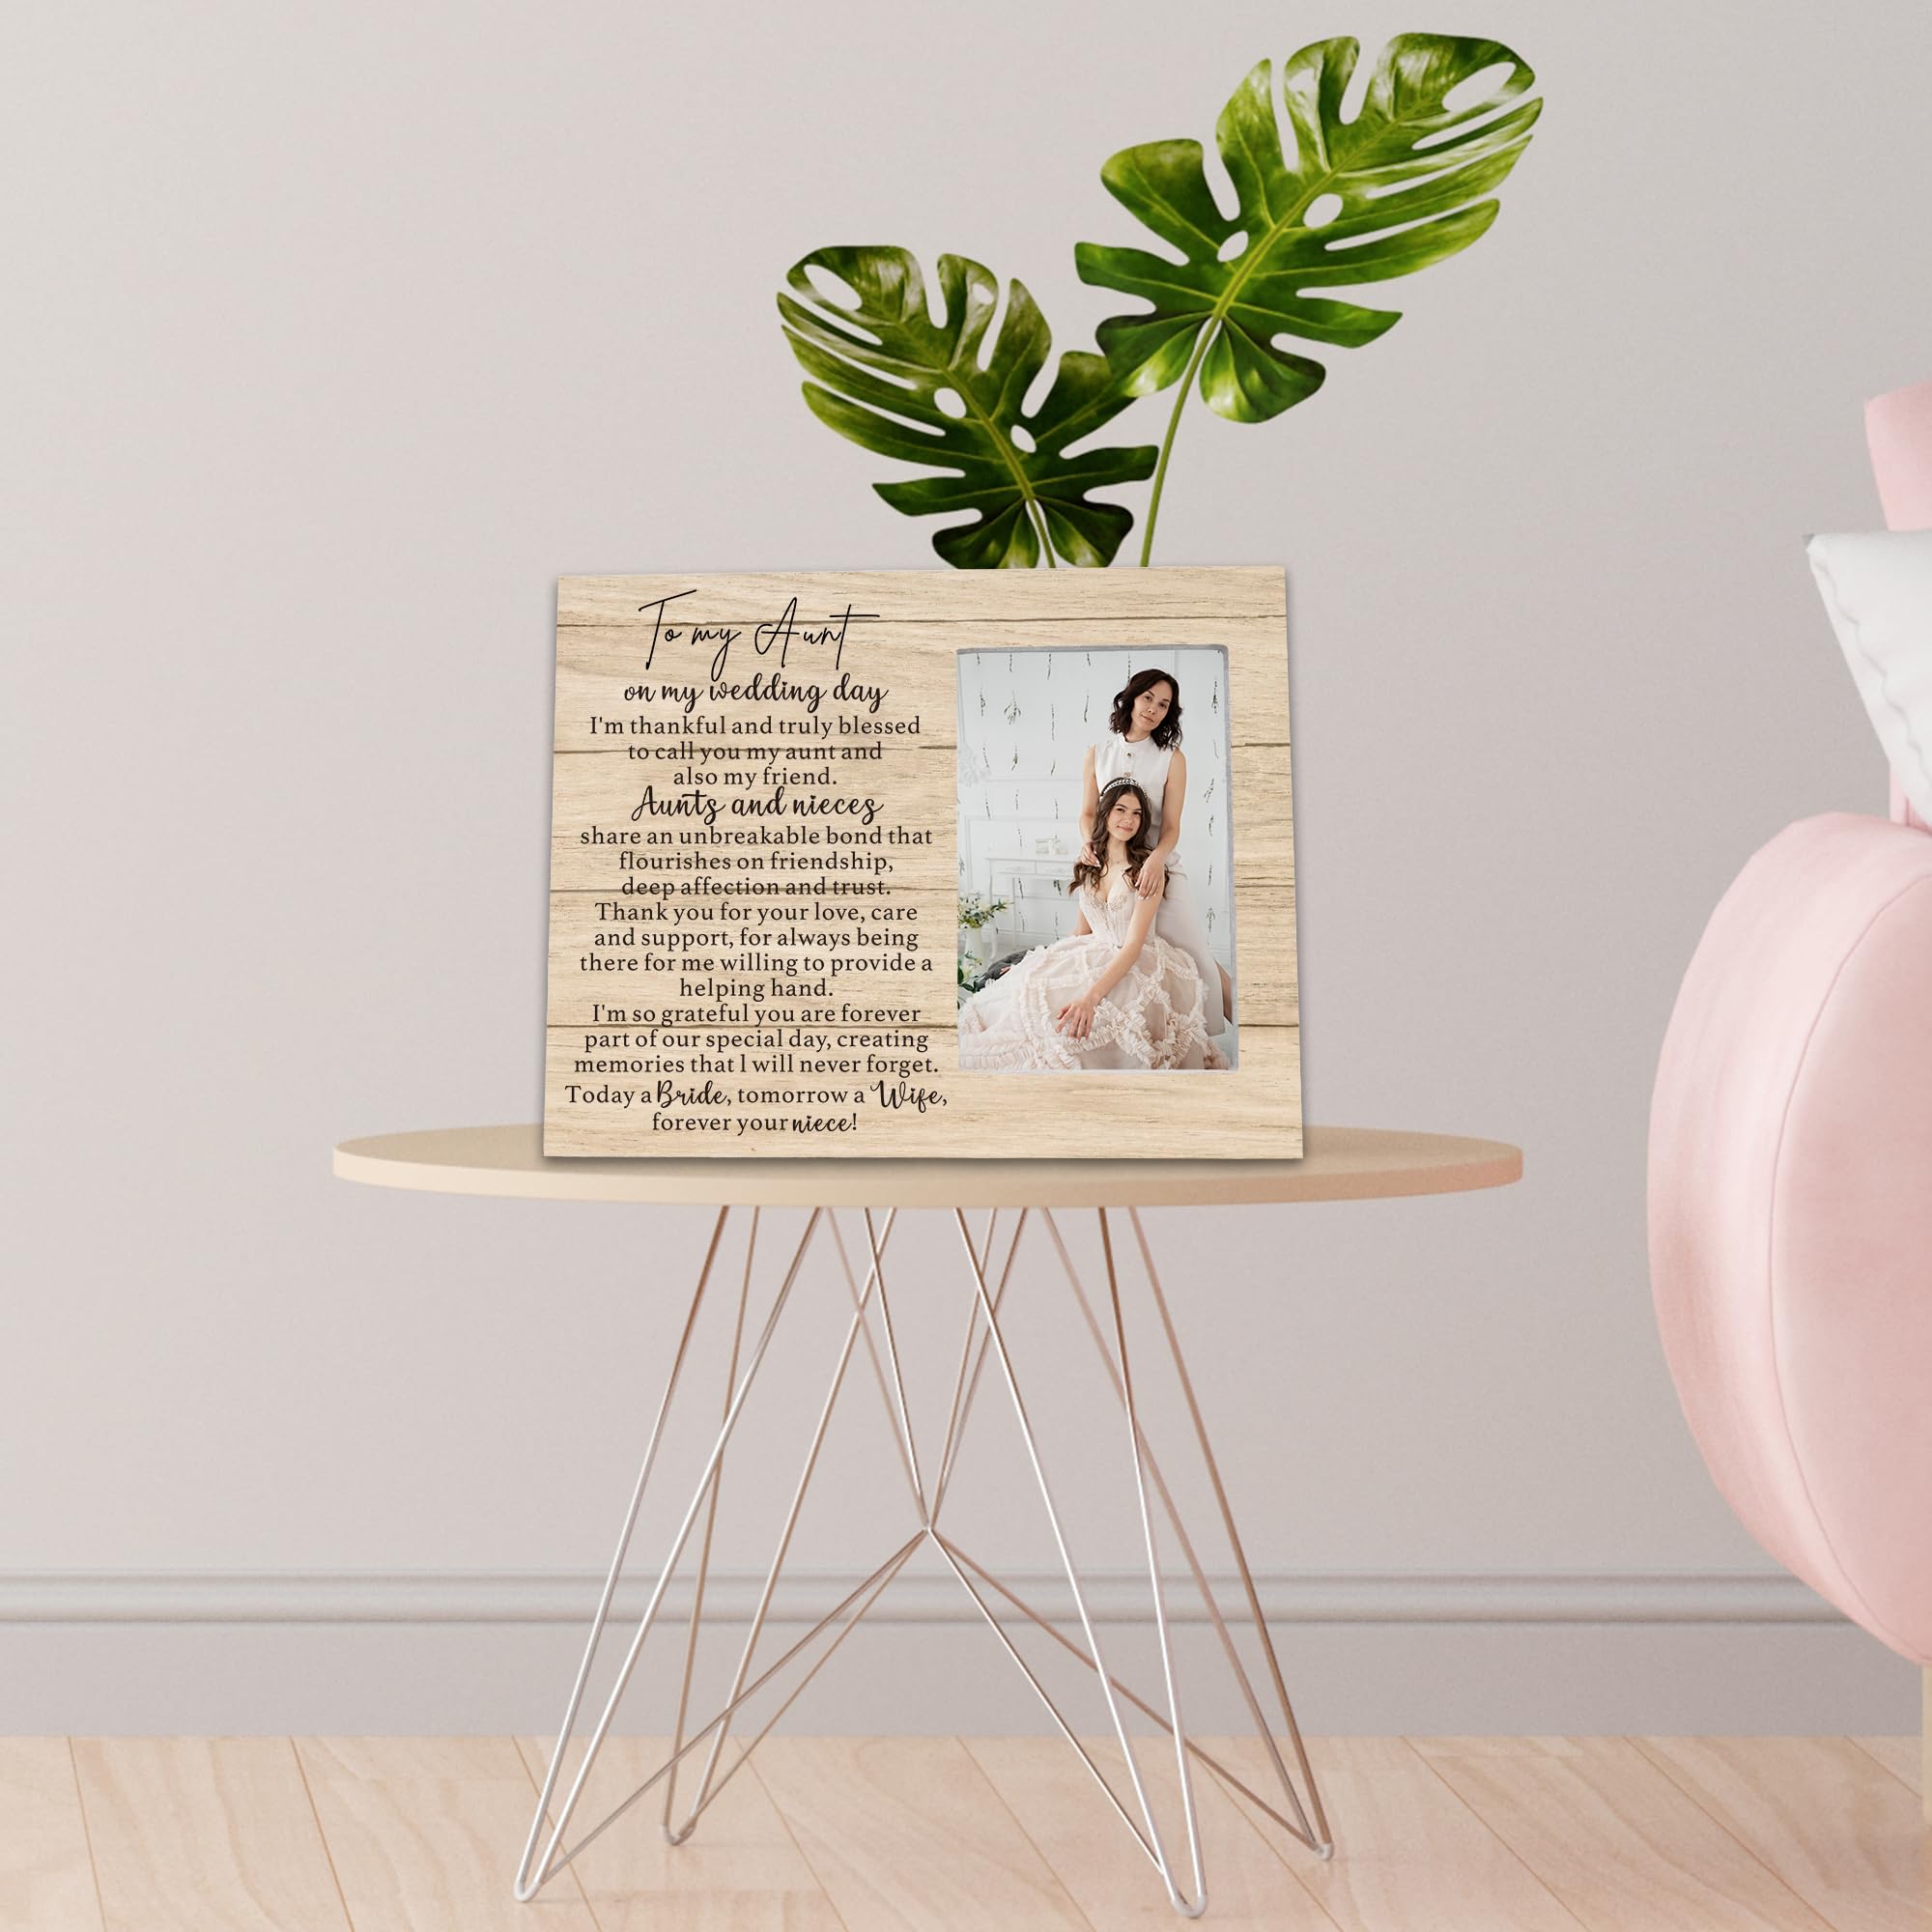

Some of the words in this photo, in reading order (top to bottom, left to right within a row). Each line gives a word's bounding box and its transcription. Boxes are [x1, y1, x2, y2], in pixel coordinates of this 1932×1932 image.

[638, 589, 697, 670] To
[691, 627, 742, 683] my
[754, 596, 880, 670] Aunt
[624, 685, 657, 702] on
[662, 685, 704, 714] my
[709, 672, 828, 714] wedding
[833, 672, 890, 714] day
[590, 716, 624, 734] I'm
[630, 715, 725, 734] thankful
[731, 715, 773, 734] and
[779, 715, 833, 740] truly
[838, 715, 921, 735] blessed
[628, 745, 649, 760] to
[655, 741, 694, 760] call
[699, 747, 741, 766] you
[746, 747, 781, 765] my
[785, 745, 836, 760] aunt
[840, 741, 882, 760] and
[673, 766, 718, 785] also
[724, 772, 756, 790] my
[763, 766, 837, 786] friend.
[631, 784, 726, 826] Aunts
[731, 783, 787, 817] and
[793, 794, 885, 826] nieces
[581, 825, 641, 844] share
[646, 832, 673, 844] an
[679, 825, 820, 844] unbreakable
[826, 825, 882, 844] bond
[888, 825, 932, 844] that
[619, 850, 731, 870] flourishes
[737, 857, 764, 869] on
[771, 850, 894, 875] friendship,
[621, 876, 675, 901] deep
[680, 875, 780, 895] affection
[785, 876, 827, 895] and
[833, 880, 891, 895] trust.
[594, 901, 668, 921] Thank
[673, 908, 714, 926] you
[720, 901, 753, 921] for
[756, 908, 810, 926] your
[814, 901, 866, 923] love,
[871, 908, 918, 921] care
[594, 926, 636, 946] and
[641, 931, 734, 952] support,
[740, 926, 772, 947] for
[777, 926, 851, 952] always
[856, 926, 919, 952] being
[581, 952, 639, 972] there
[644, 952, 676, 972] for
[682, 958, 715, 972] me
[720, 952, 798, 978] willing
[804, 956, 825, 972] to
[831, 952, 916, 978] provide
[922, 958, 932, 972] a
[679, 978, 765, 1003] helping
[771, 978, 834, 997] hand.
[592, 1004, 627, 1022] I'm
[632, 1009, 656, 1022] so
[661, 1003, 749, 1028] grateful
[753, 1009, 795, 1028] you
[801, 1009, 836, 1022] are
[841, 1003, 922, 1022] forever
[584, 1033, 630, 1053] part
[635, 1029, 657, 1047] of
[662, 1035, 701, 1047] our
[705, 1028, 783, 1053] special
[788, 1028, 832, 1053] day,
[837, 1029, 929, 1053] creating
[575, 1054, 685, 1074] memories
[691, 1053, 734, 1073] that
[752, 1054, 793, 1072] will
[800, 1060, 862, 1073] never
[867, 1053, 938, 1079] forget.
[564, 1084, 636, 1109] Today
[640, 1091, 652, 1103] a
[657, 1079, 731, 1109] Bride,
[738, 1089, 848, 1103] tomorrow
[854, 1091, 865, 1103] a
[869, 1080, 948, 1114] Wife,
[652, 1112, 731, 1132] forever
[736, 1118, 789, 1136] your
[792, 1113, 857, 1134] niece!
